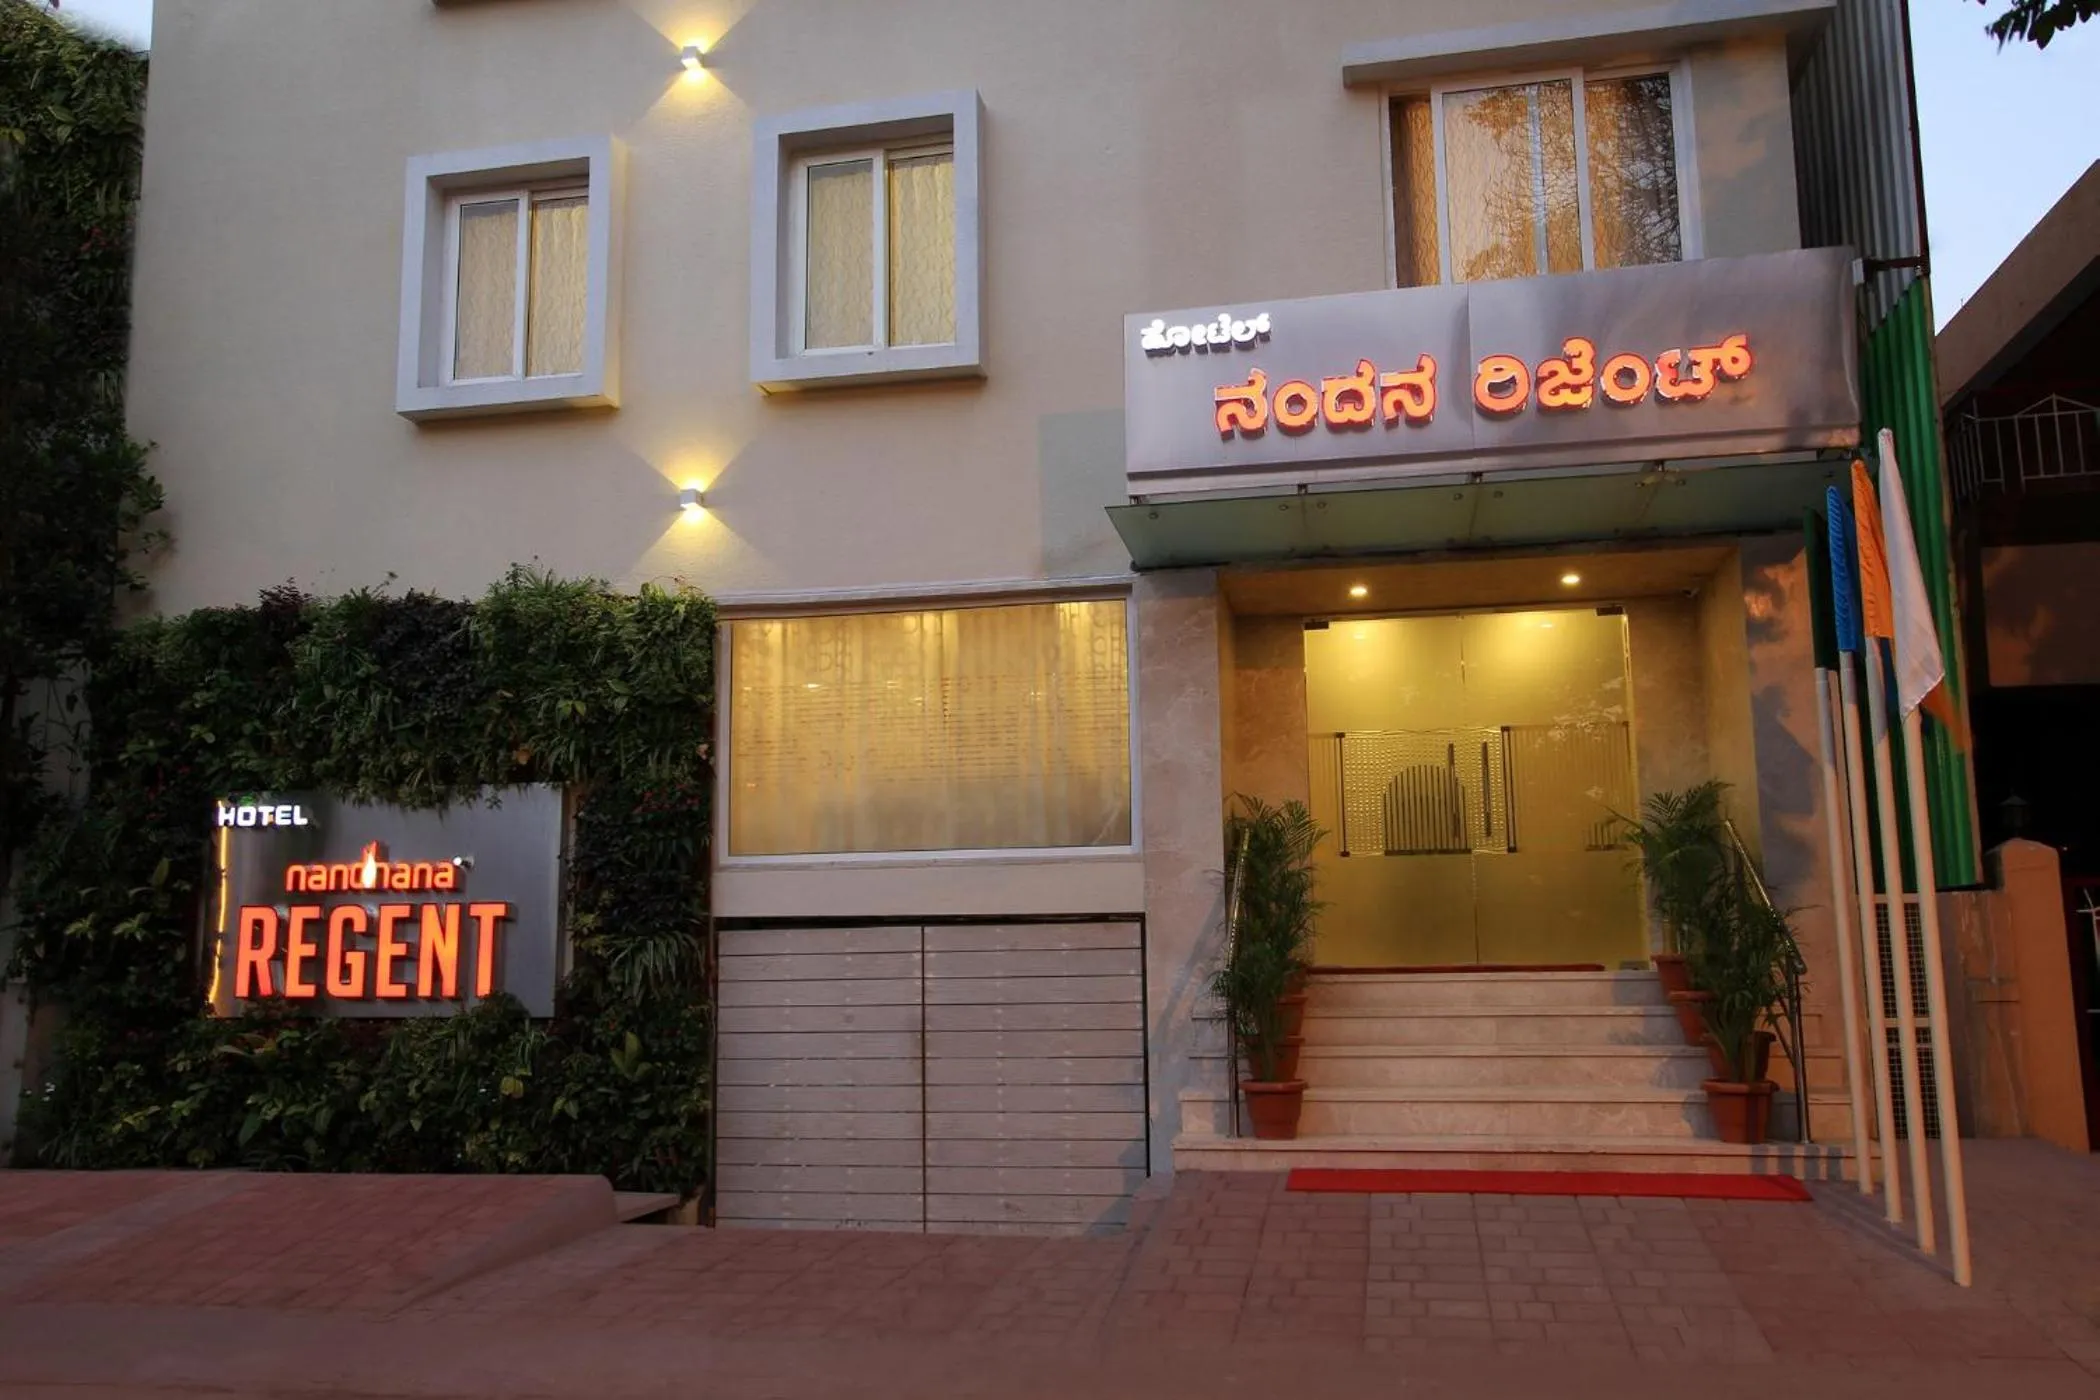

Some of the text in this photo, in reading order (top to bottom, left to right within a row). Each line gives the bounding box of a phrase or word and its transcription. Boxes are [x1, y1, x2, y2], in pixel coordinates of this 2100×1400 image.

[1214, 334, 1753, 437] ನಂದನ ರಿಜೆಂಟ್
[217, 805, 308, 827] HOTEL
[234, 902, 508, 999] REGENT
